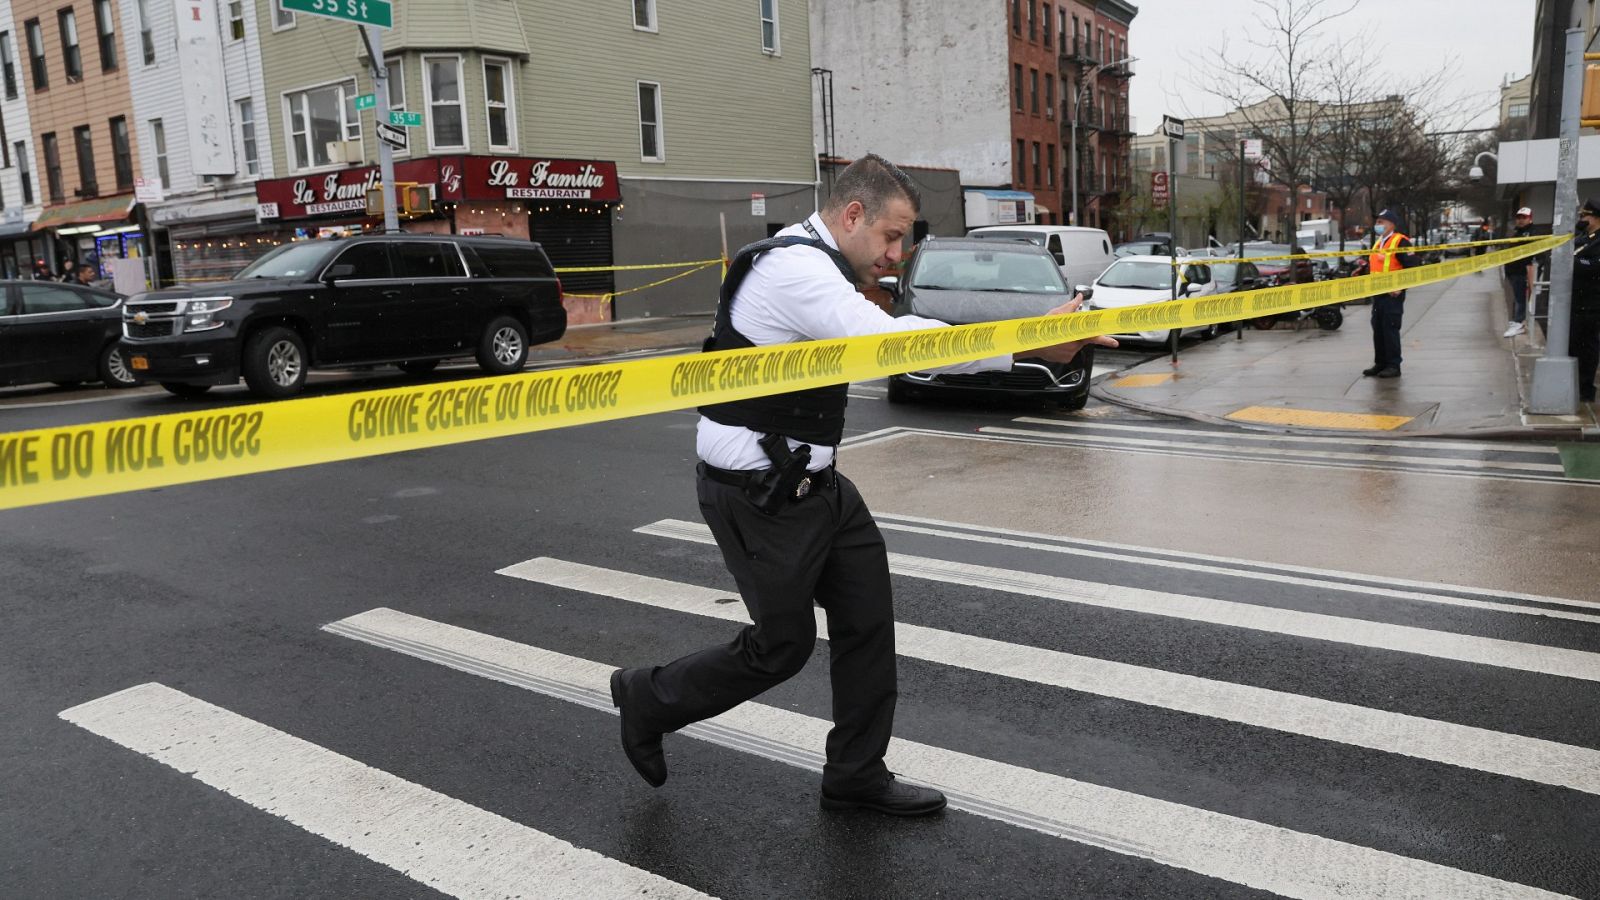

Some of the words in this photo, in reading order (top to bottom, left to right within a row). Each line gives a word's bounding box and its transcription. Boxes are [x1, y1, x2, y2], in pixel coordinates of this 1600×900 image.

[347, 0, 368, 18] St
[393, 113, 405, 124] 35
[407, 113, 416, 122] ST
[487, 160, 518, 186] La
[529, 161, 604, 188] Familia
[292, 179, 315, 205] La
[324, 170, 381, 201] Famili
[512, 189, 586, 198] RESTAURANT
[310, 201, 366, 213] RESTAURAN
